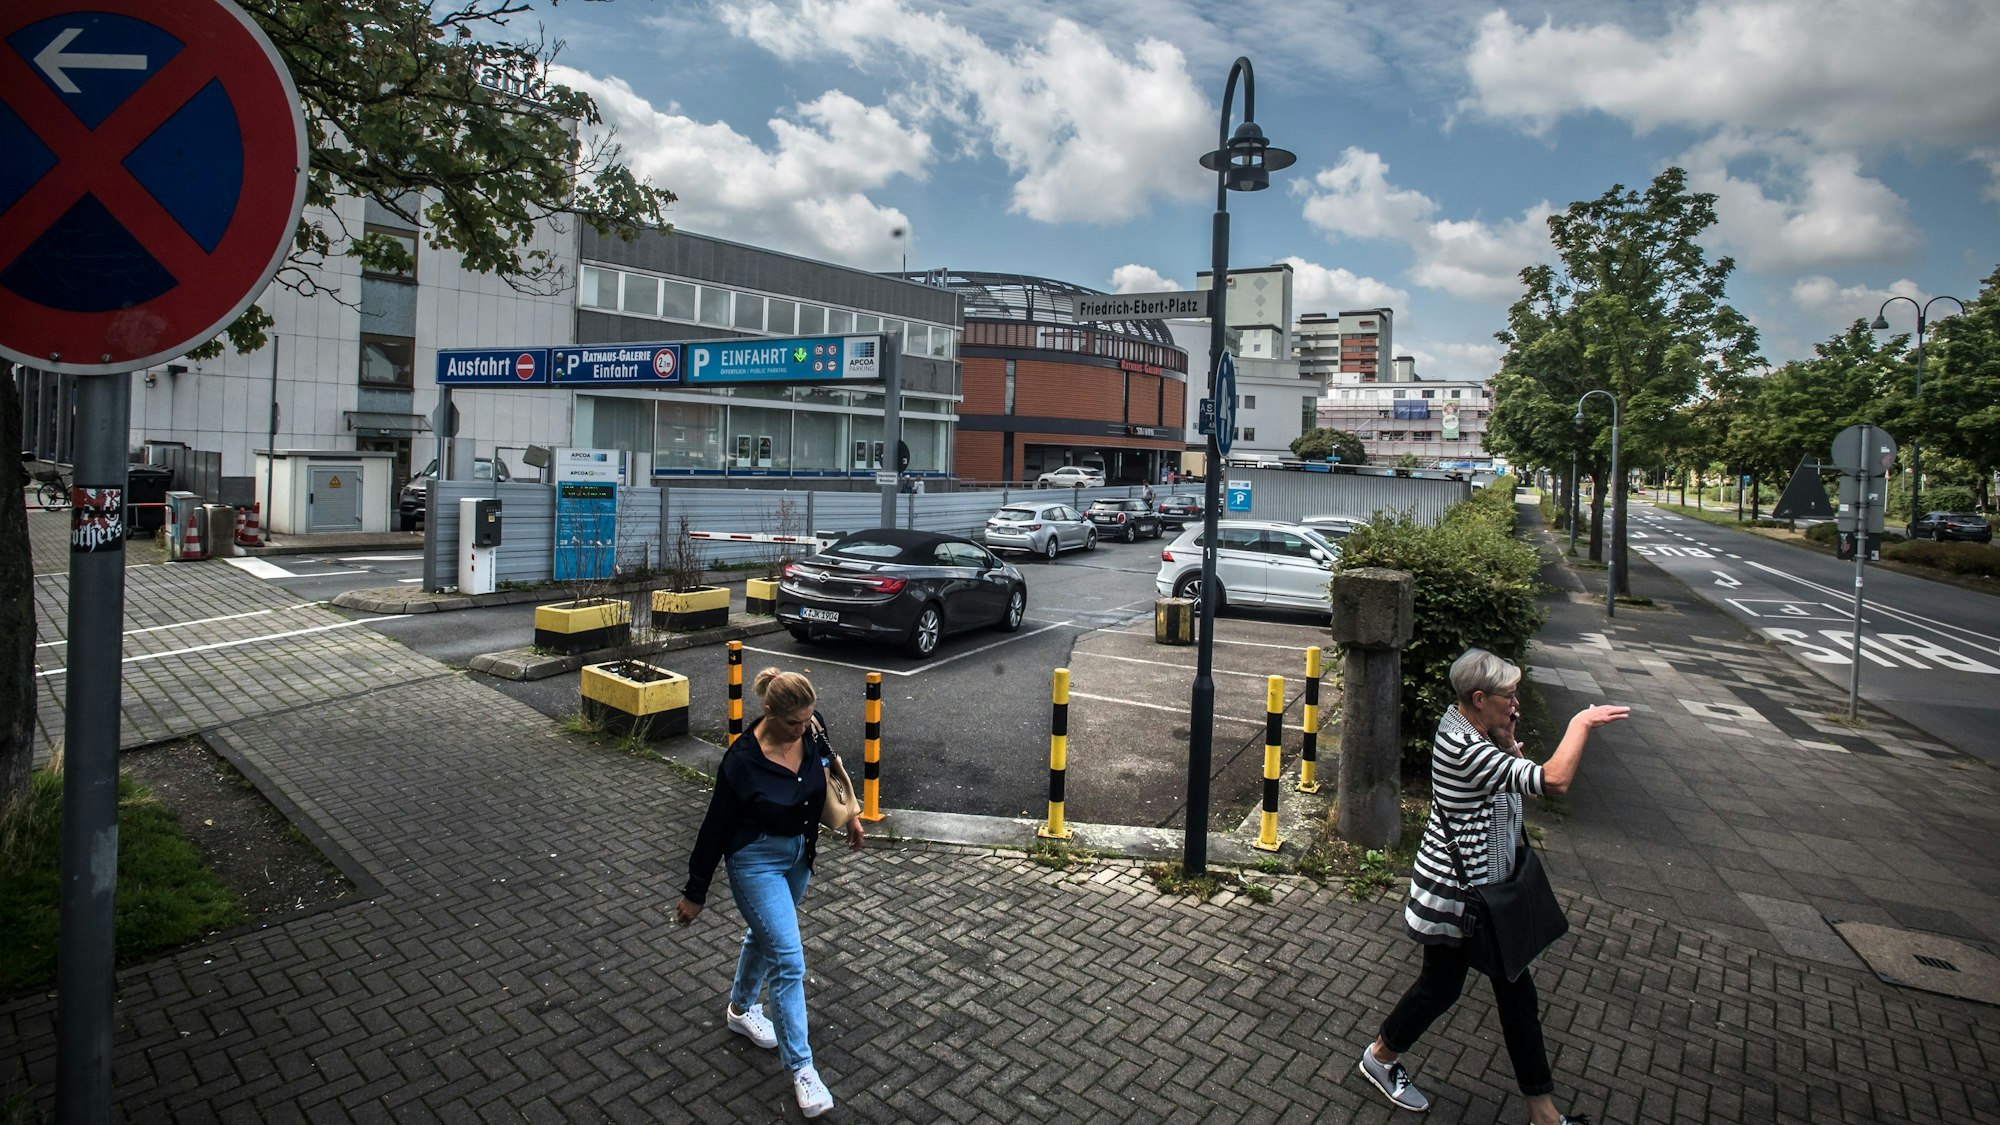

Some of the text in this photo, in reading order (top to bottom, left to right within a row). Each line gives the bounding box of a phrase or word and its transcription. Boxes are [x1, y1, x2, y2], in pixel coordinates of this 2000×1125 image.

[1080, 298, 1198, 316] Friedrich-Ebert-Platz
[567, 355, 580, 375] P
[582, 350, 651, 363] RATHAUS-GALERIE
[693, 348, 710, 377] P
[721, 347, 787, 366] EINFAHRT
[447, 357, 510, 376] Ausfahrt
[593, 363, 639, 379] Einfahrt
[1236, 494, 1245, 505] P
[1630, 545, 1716, 559] BUS
[1762, 627, 2000, 675] BUS
